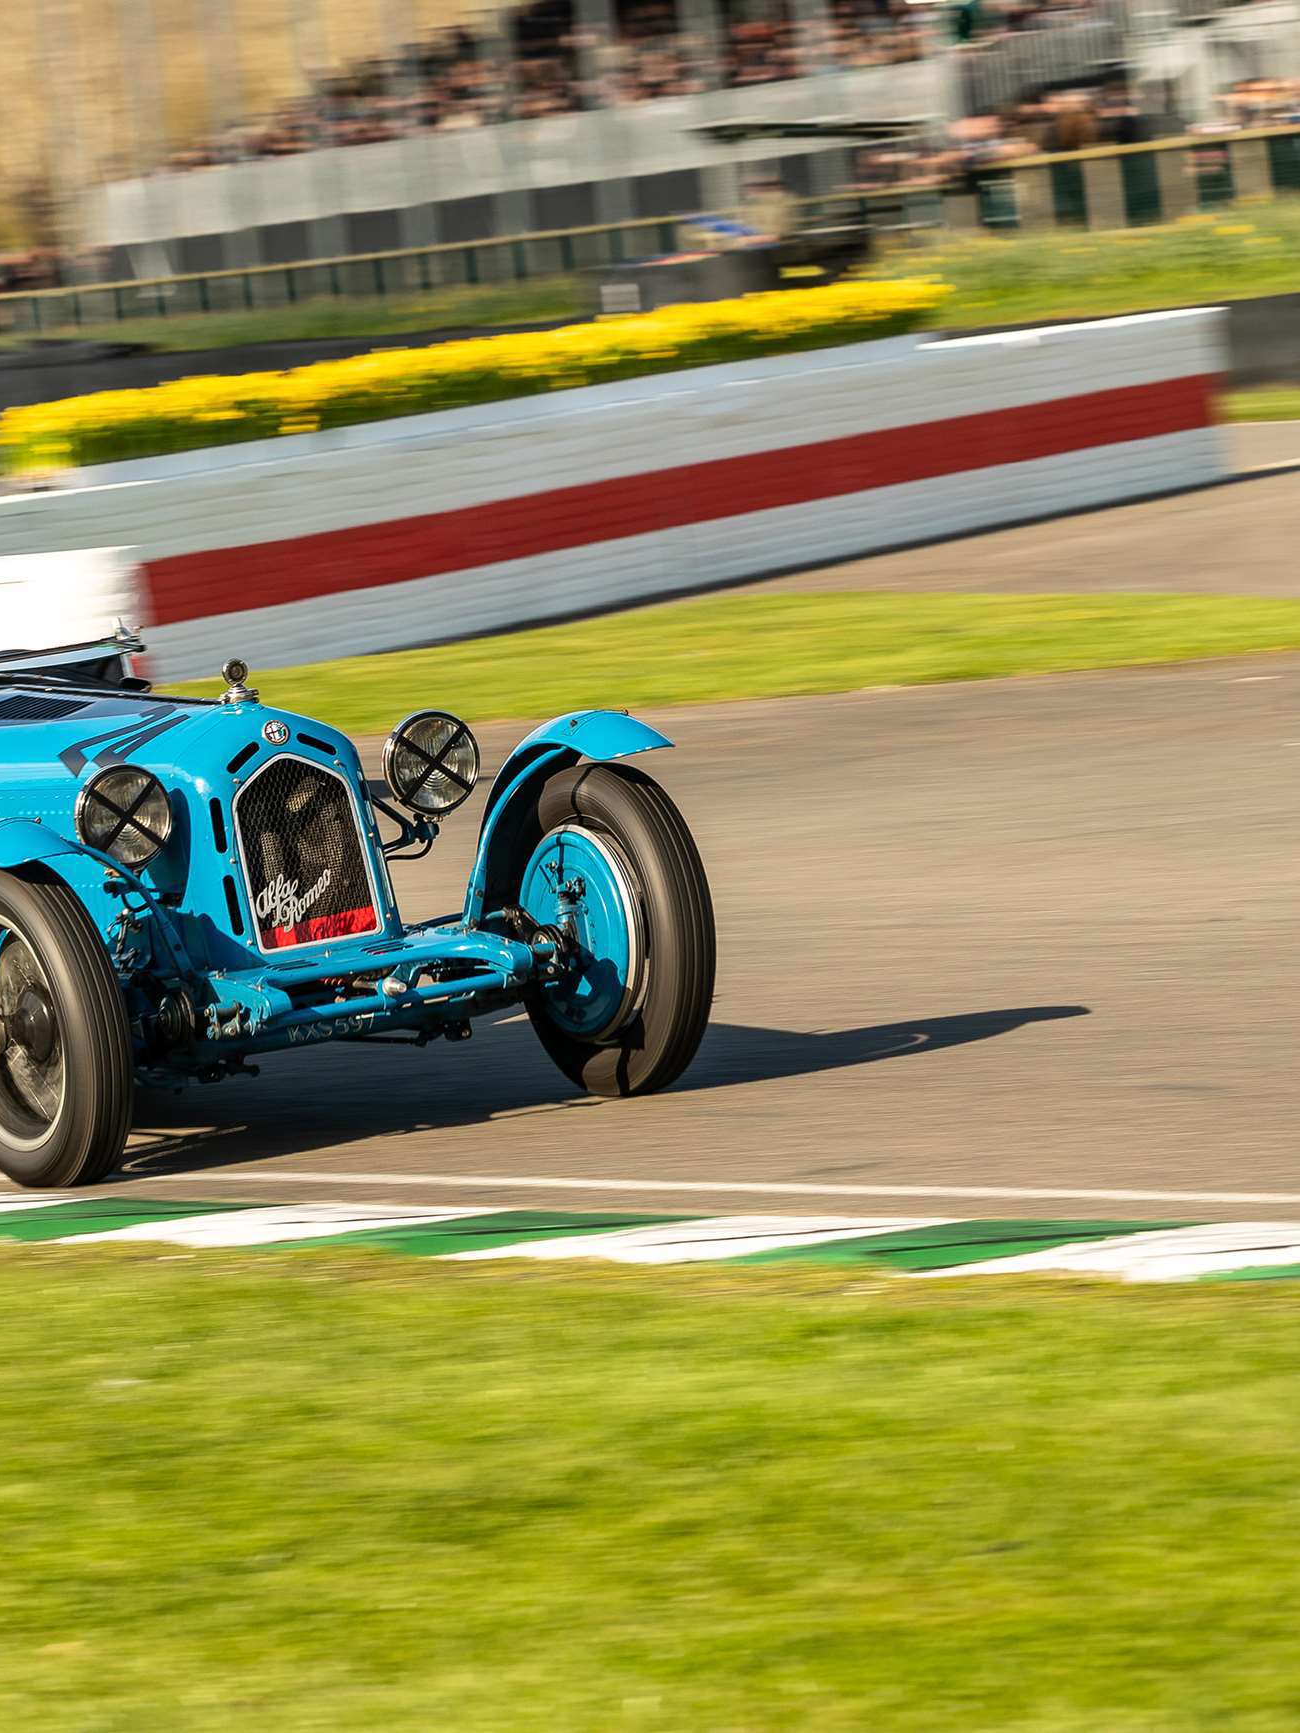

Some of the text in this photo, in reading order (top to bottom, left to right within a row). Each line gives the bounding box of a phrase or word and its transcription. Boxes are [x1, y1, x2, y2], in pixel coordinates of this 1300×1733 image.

[256, 874, 298, 925] Alfa
[277, 869, 331, 932] Romeo
[288, 1021, 332, 1041] KXS
